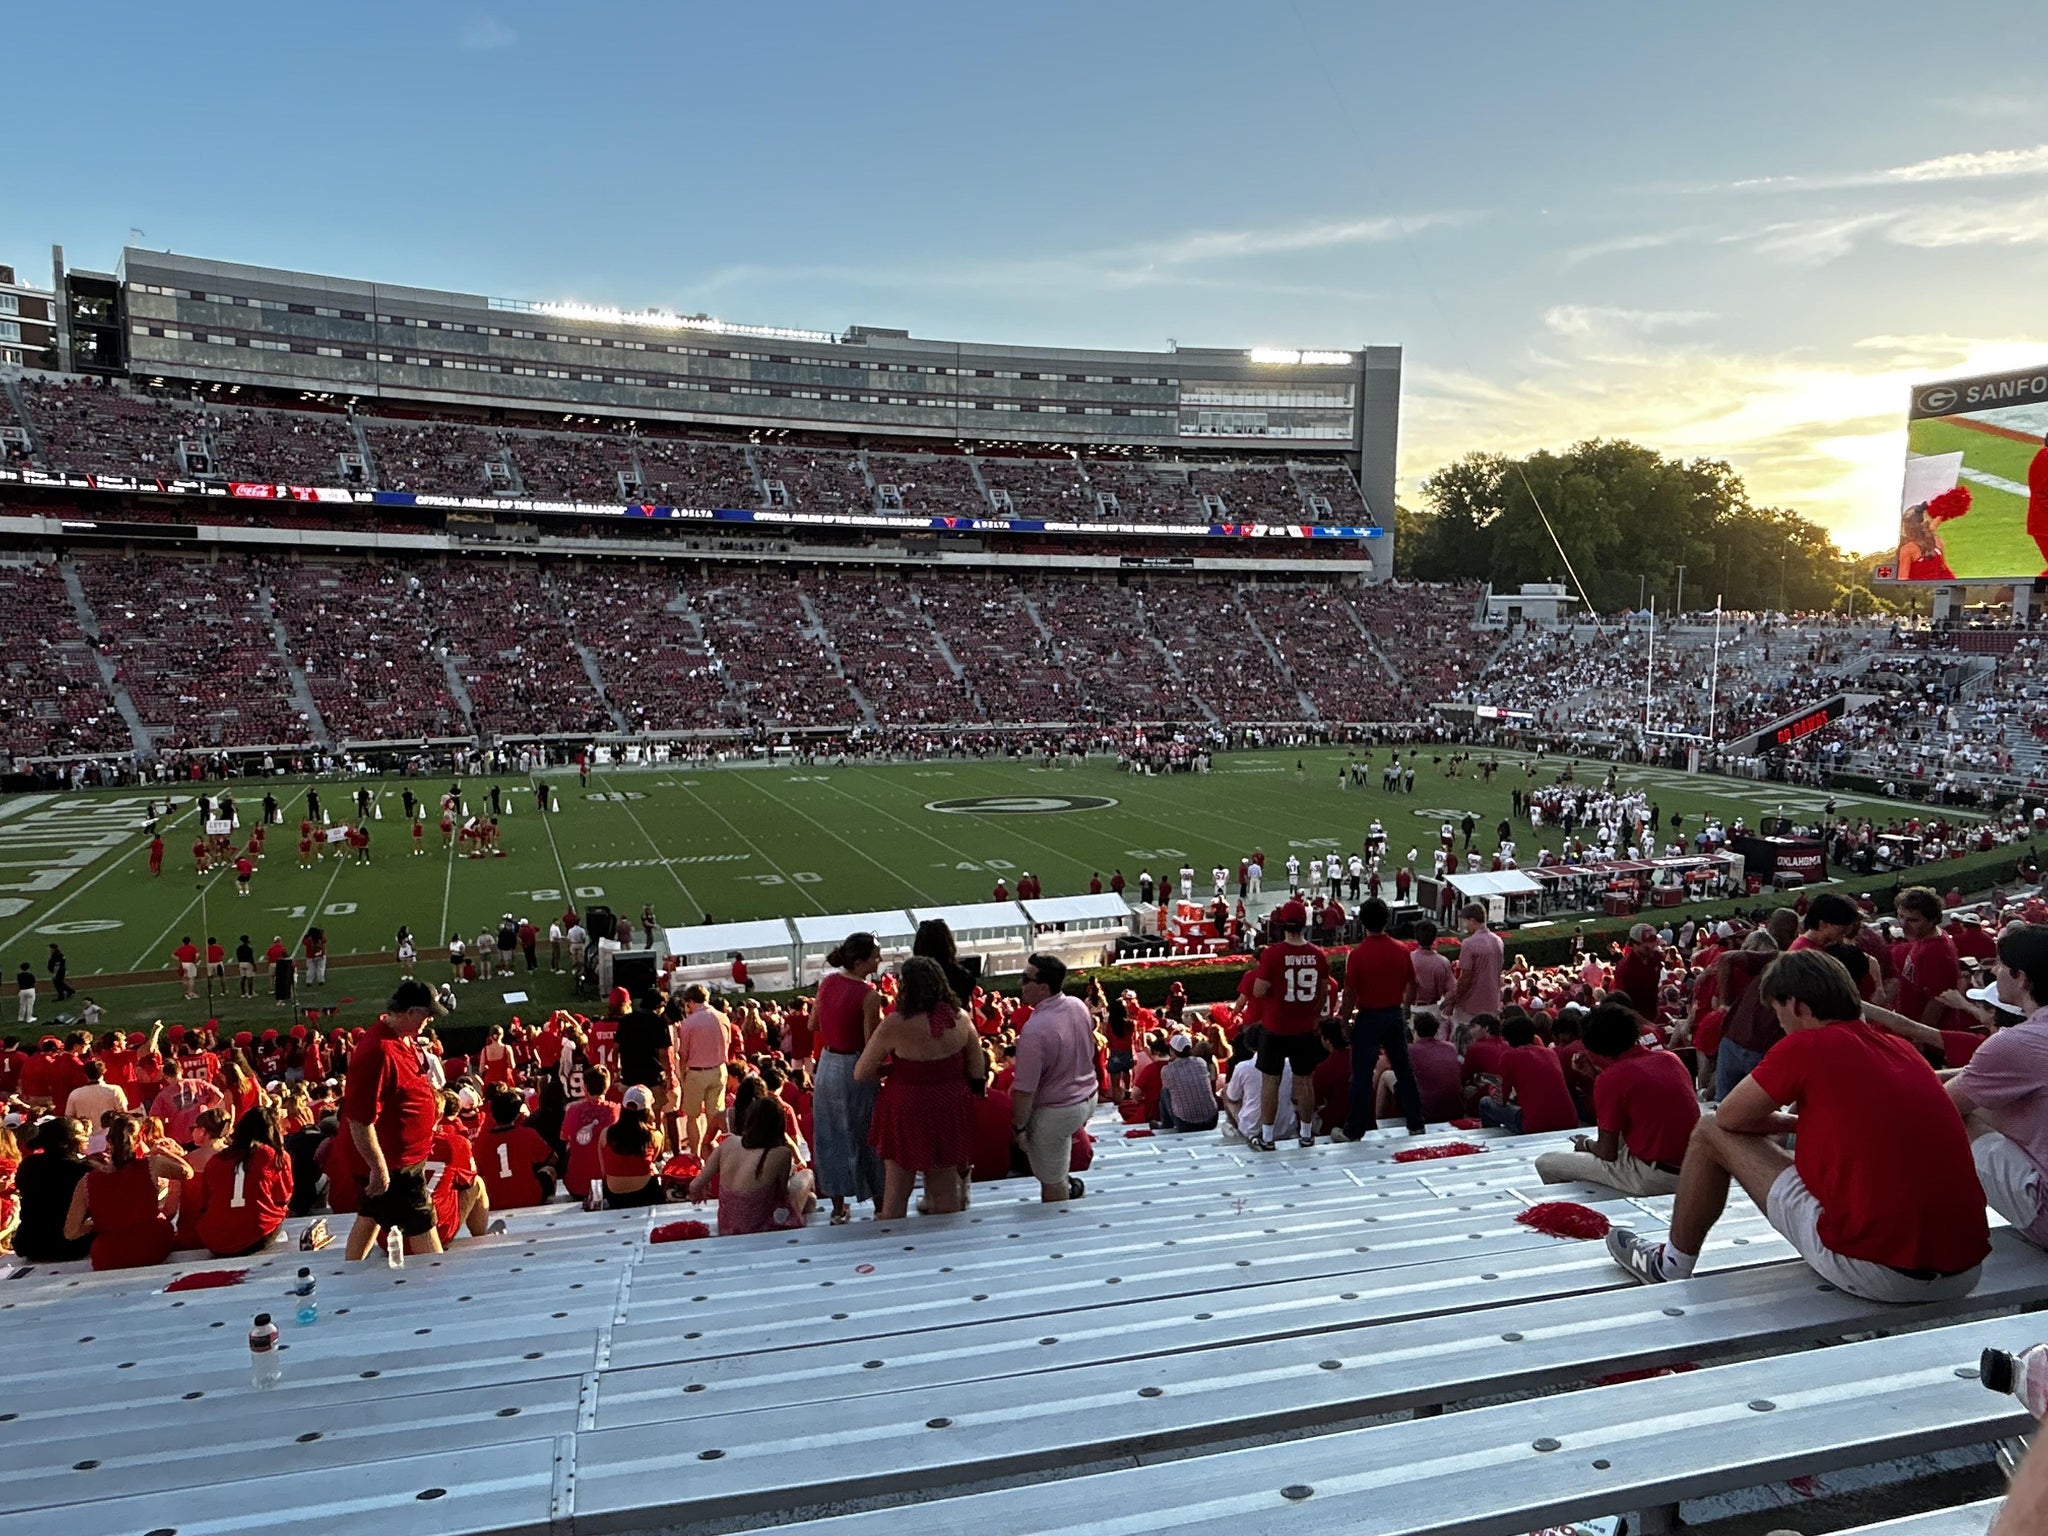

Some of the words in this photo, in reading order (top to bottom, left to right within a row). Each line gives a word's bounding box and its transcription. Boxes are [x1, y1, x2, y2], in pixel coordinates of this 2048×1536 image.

[682, 508, 713, 519] DELTA
[1777, 728, 1792, 744] GO
[1794, 709, 1829, 736] DAWGS
[956, 859, 1016, 871] 40
[1776, 855, 1822, 867] OKLAHOMA
[755, 872, 823, 886] 30
[1215, 871, 1226, 881] 57
[531, 886, 605, 901] 20
[288, 902, 358, 918] 10
[1285, 955, 1316, 966] BOWERS
[1284, 968, 1318, 1002] 19
[497, 1142, 513, 1179] 1
[231, 1161, 246, 1207] 1
[1632, 1249, 1647, 1273] N
